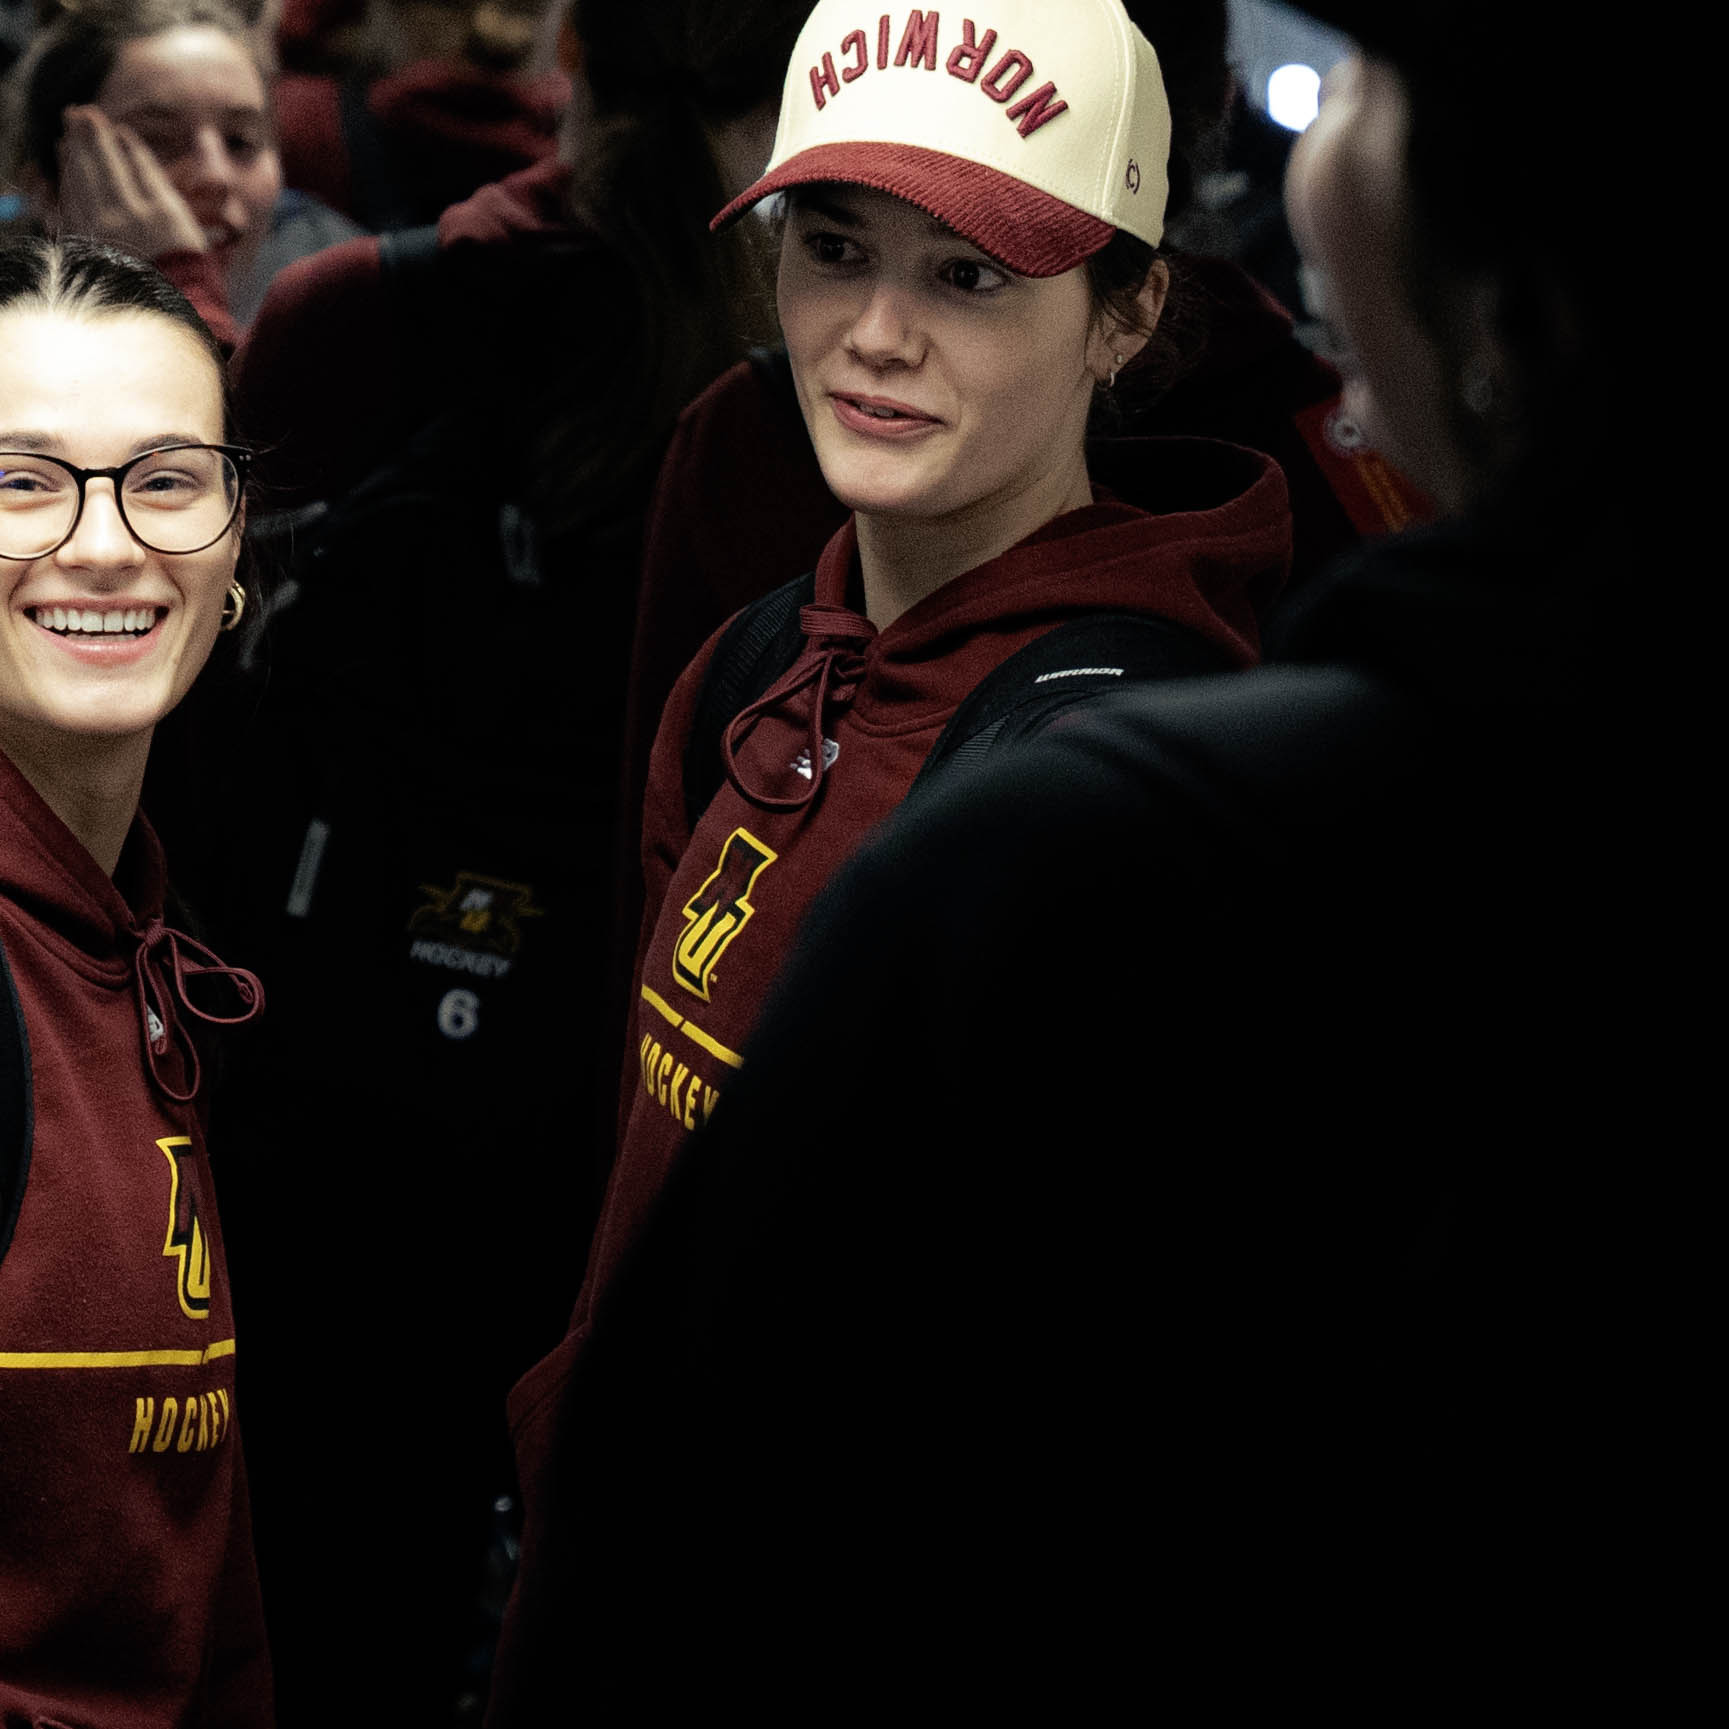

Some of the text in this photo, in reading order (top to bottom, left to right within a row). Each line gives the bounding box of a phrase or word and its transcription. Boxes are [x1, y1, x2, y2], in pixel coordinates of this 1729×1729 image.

[808, 9, 1069, 139] NORWICH
[437, 988, 480, 1040] 6
[129, 1386, 231, 1454] HOCKEY
